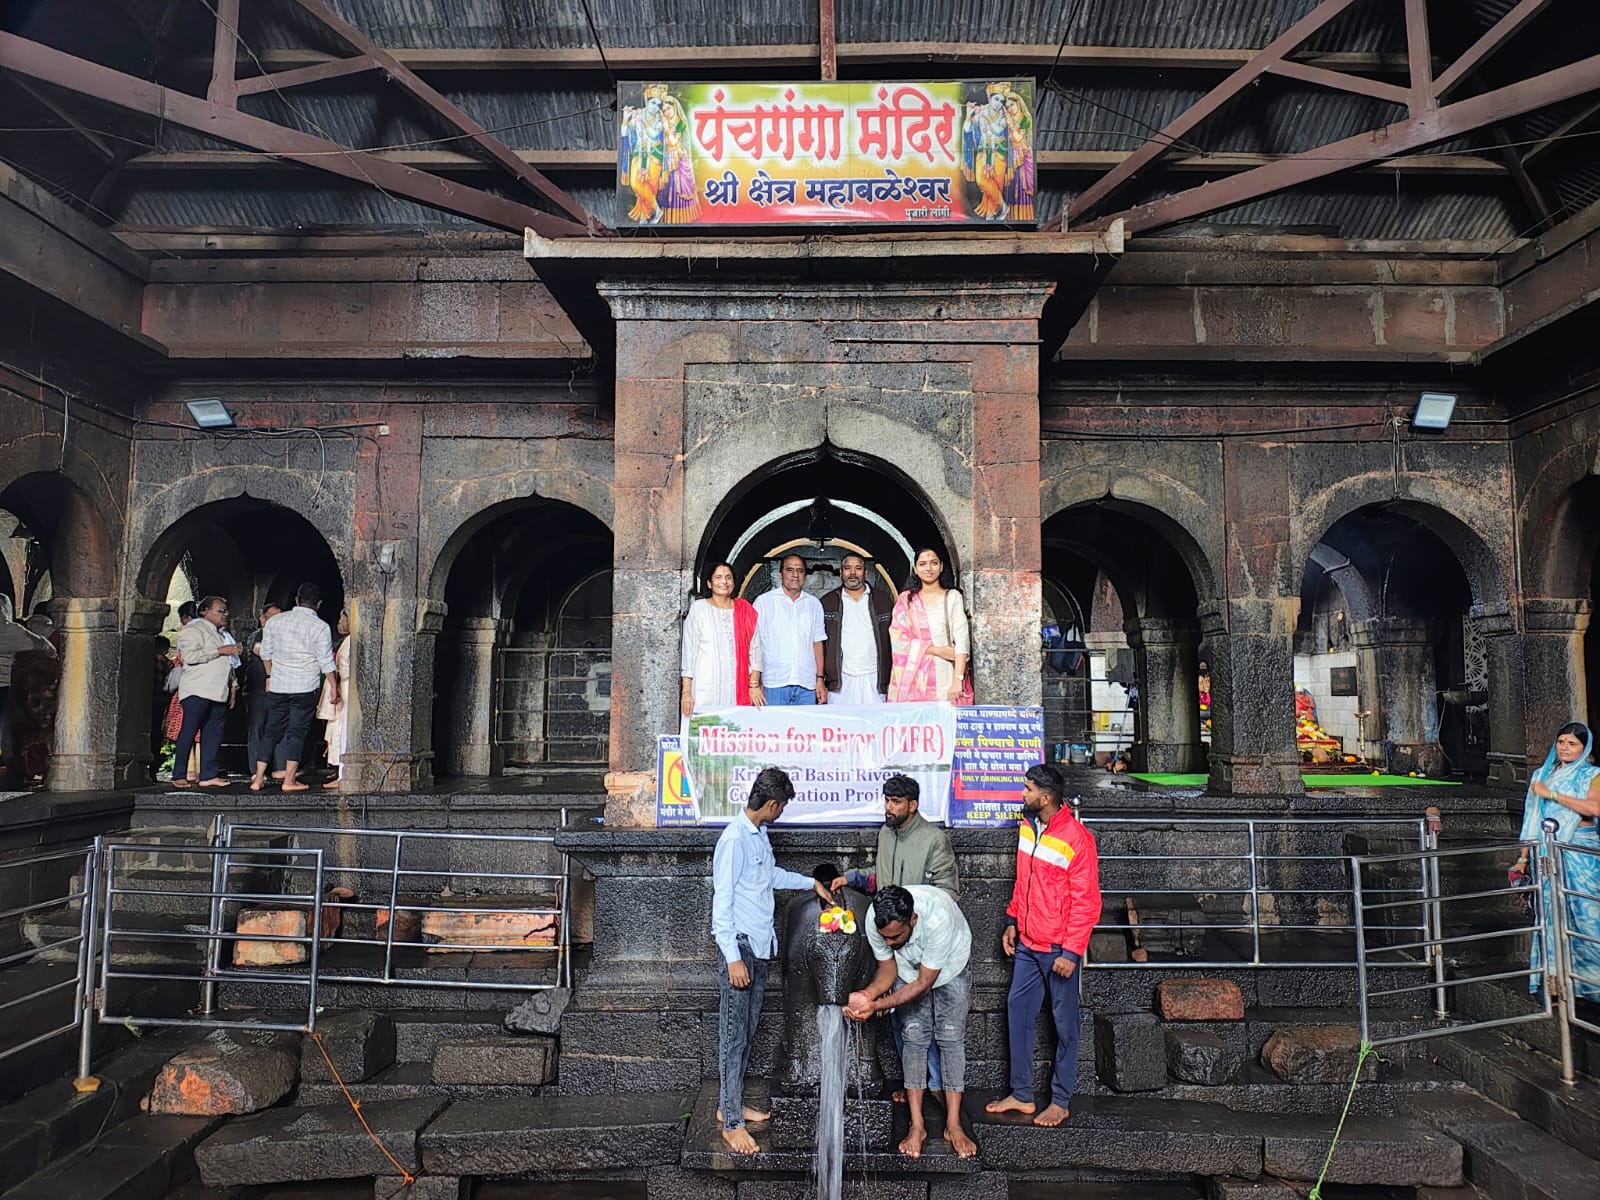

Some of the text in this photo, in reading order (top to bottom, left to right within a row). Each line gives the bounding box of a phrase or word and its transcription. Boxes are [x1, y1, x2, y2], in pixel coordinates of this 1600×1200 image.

[694, 87, 955, 162] पंचगंगा मंदिर
[705, 169, 951, 209] श्री क्षेत्र महाबळेश्वर
[701, 727, 780, 753] Mission
[786, 726, 817, 753] for
[1017, 736, 1041, 748] पाणी
[805, 767, 851, 781] Basin
[981, 775, 1012, 783] DRINKING
[845, 787, 881, 803] Proj
[966, 811, 991, 819] KEEP
